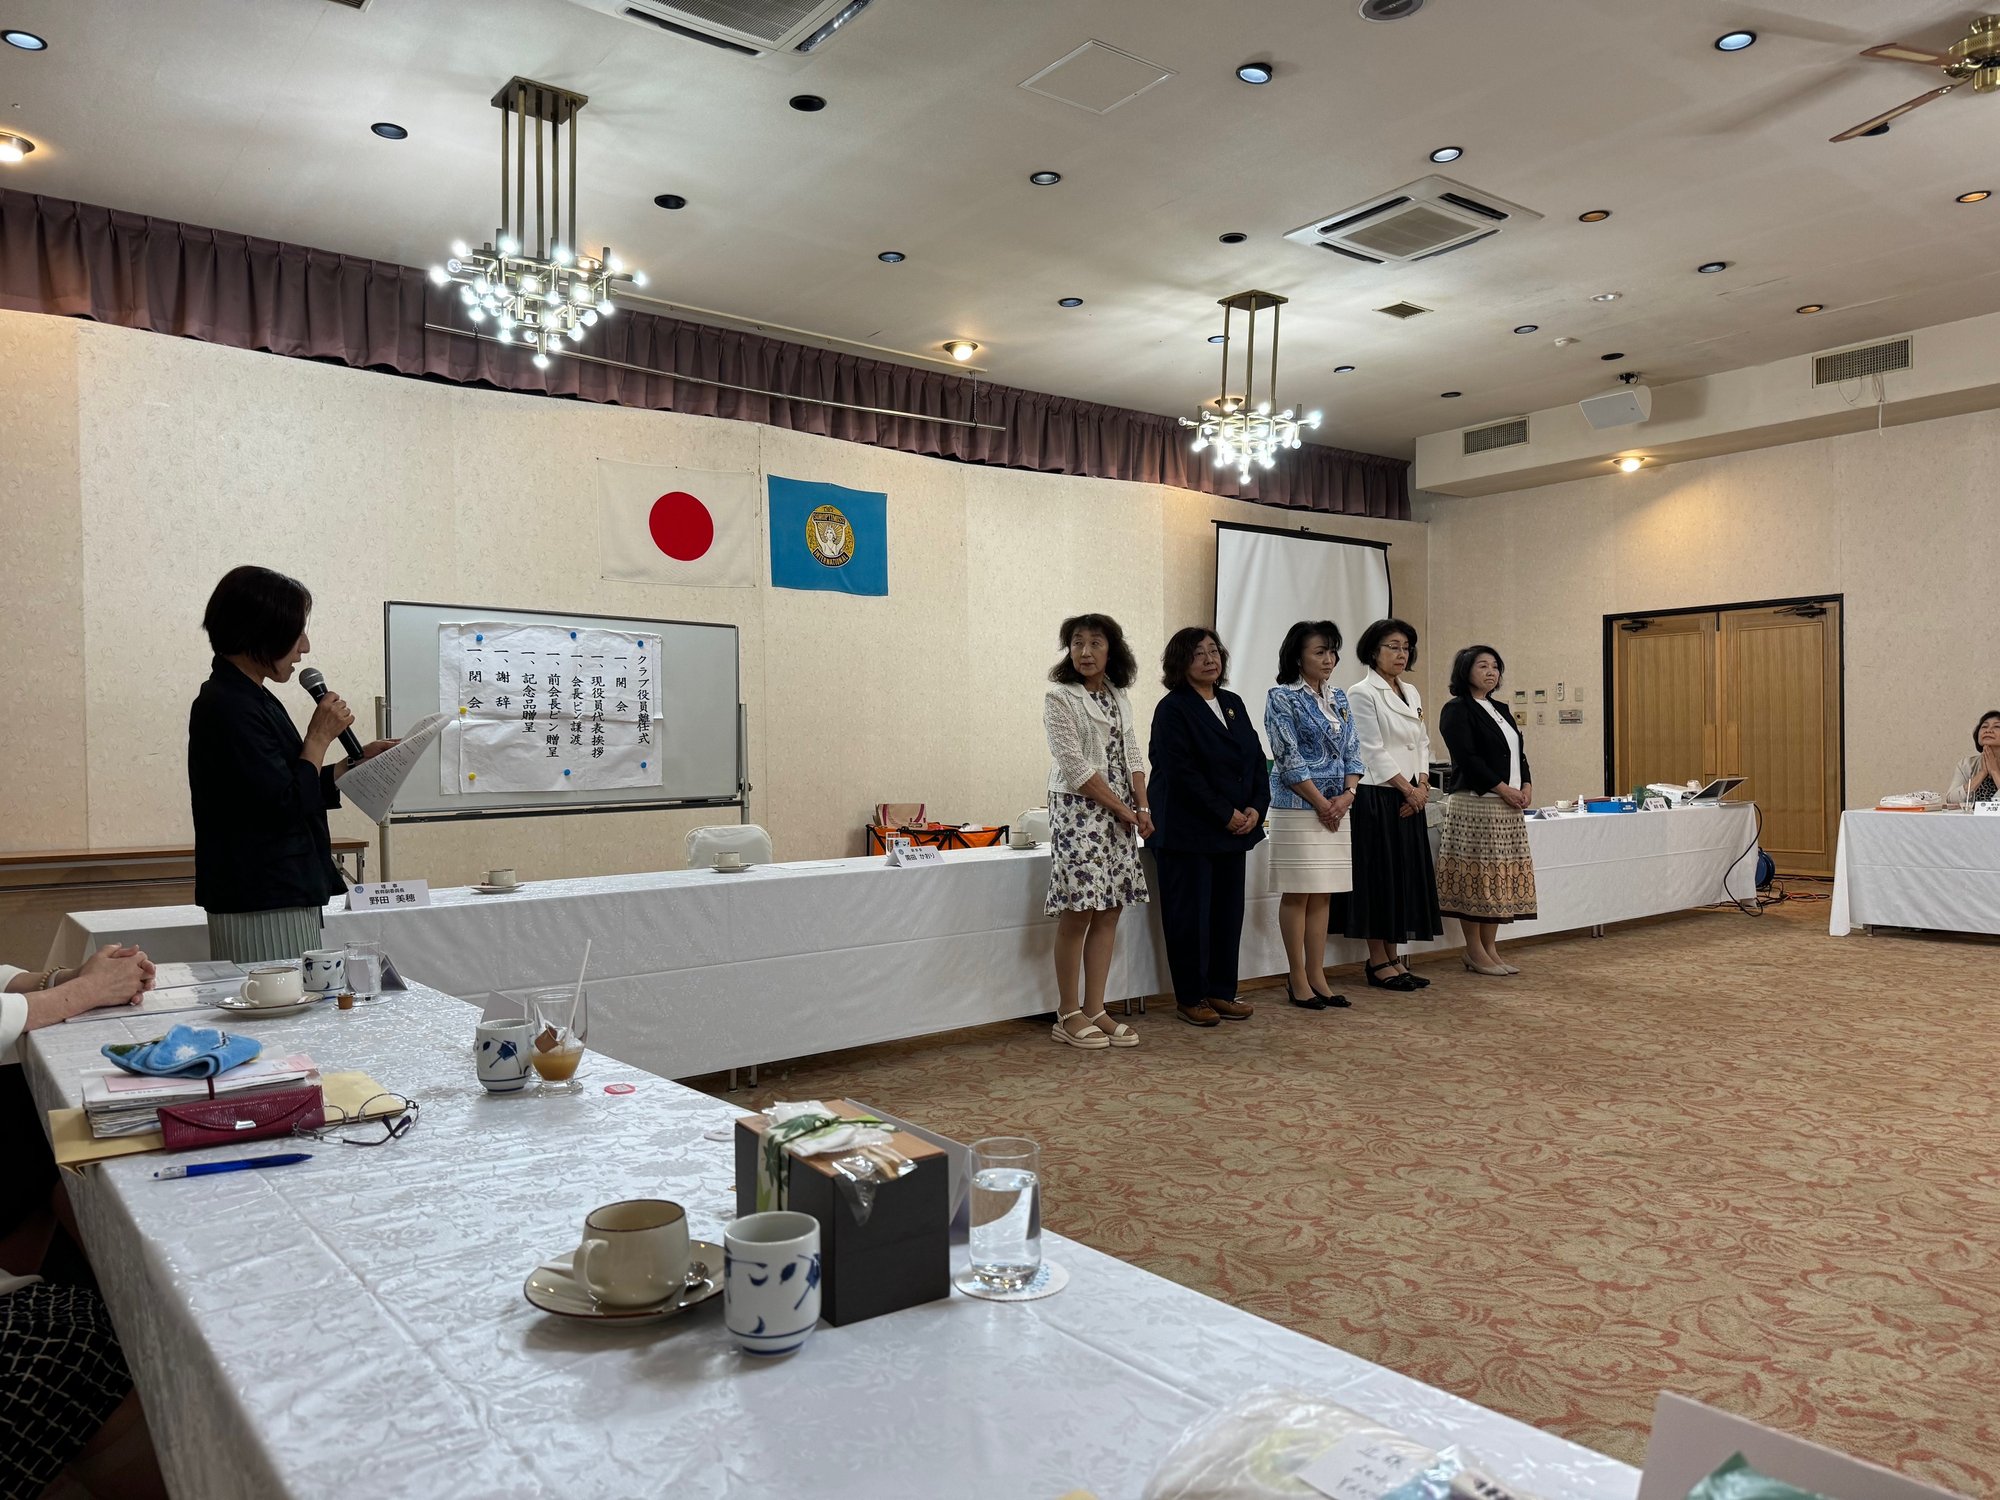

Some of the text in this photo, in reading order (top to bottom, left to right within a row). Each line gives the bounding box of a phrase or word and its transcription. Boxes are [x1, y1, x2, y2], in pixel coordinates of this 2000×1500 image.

[814, 551, 849, 566] INTERNATIONAL
[637, 655, 651, 745] クラブ役員離任式
